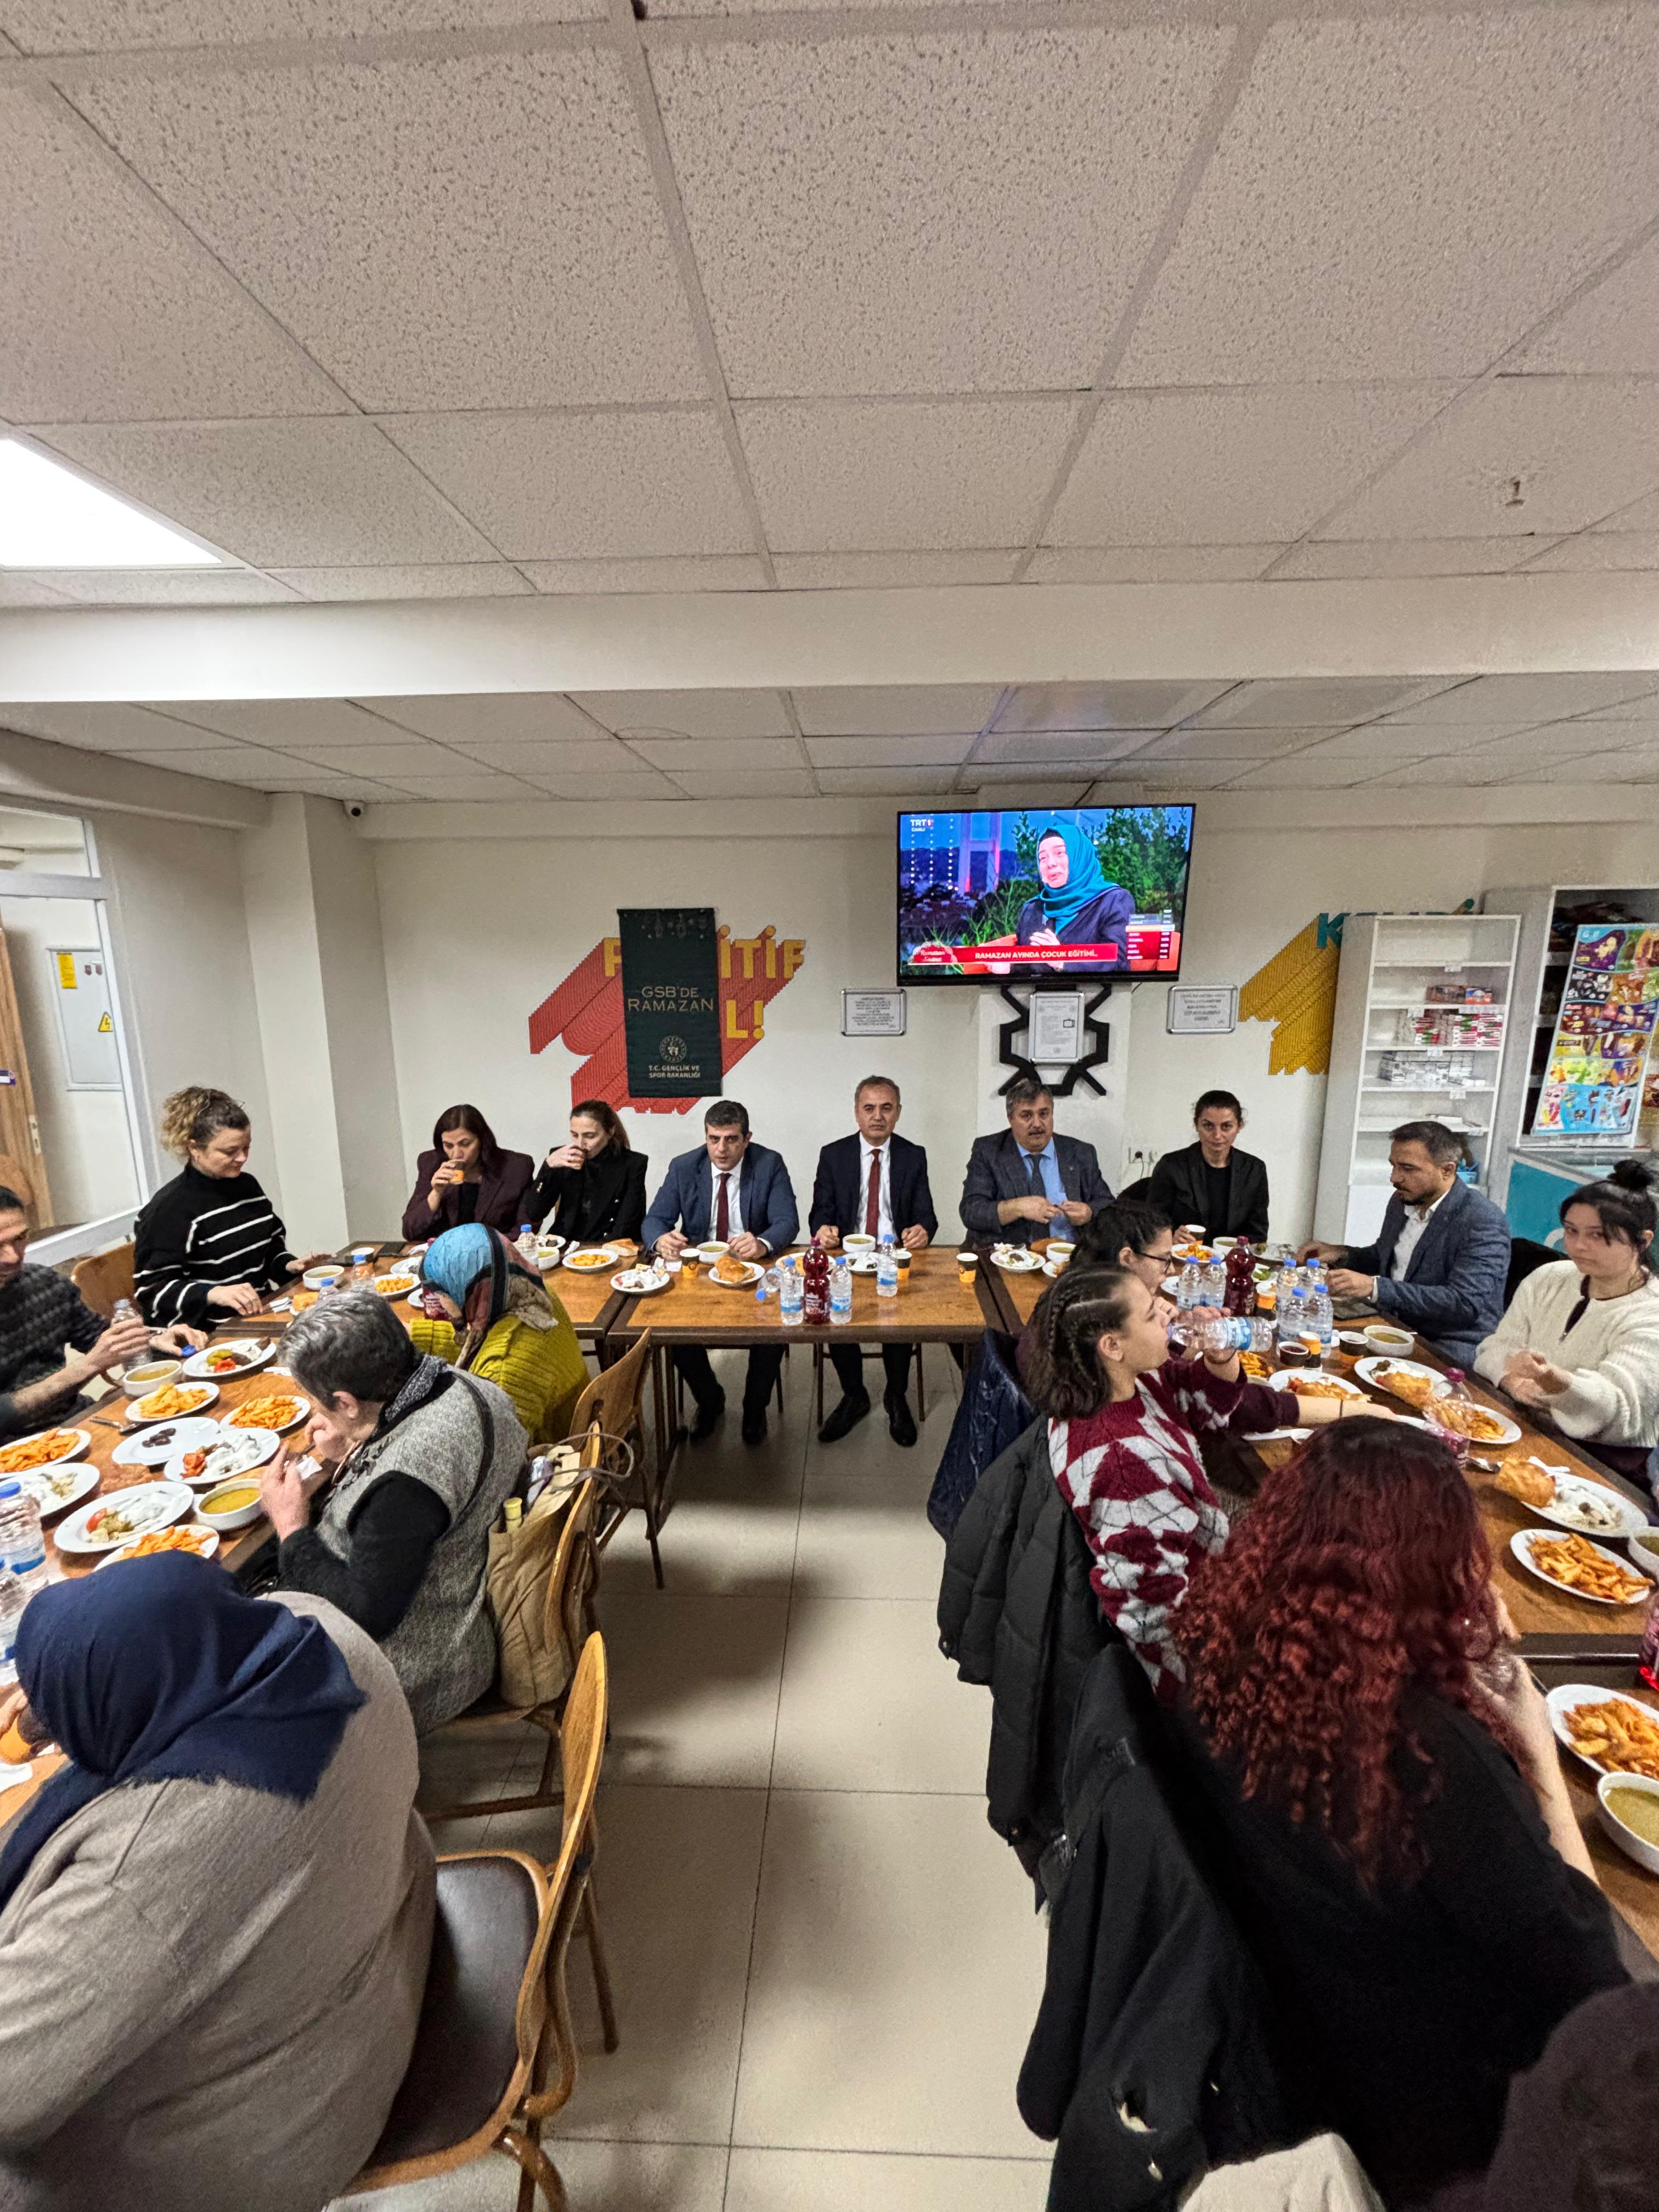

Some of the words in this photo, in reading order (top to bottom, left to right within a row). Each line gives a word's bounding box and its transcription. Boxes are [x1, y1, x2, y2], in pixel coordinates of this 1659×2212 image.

[603, 924, 806, 979] PİTİF
[627, 998, 714, 1012] RAMAZAN
[726, 1000, 765, 1039] L!
